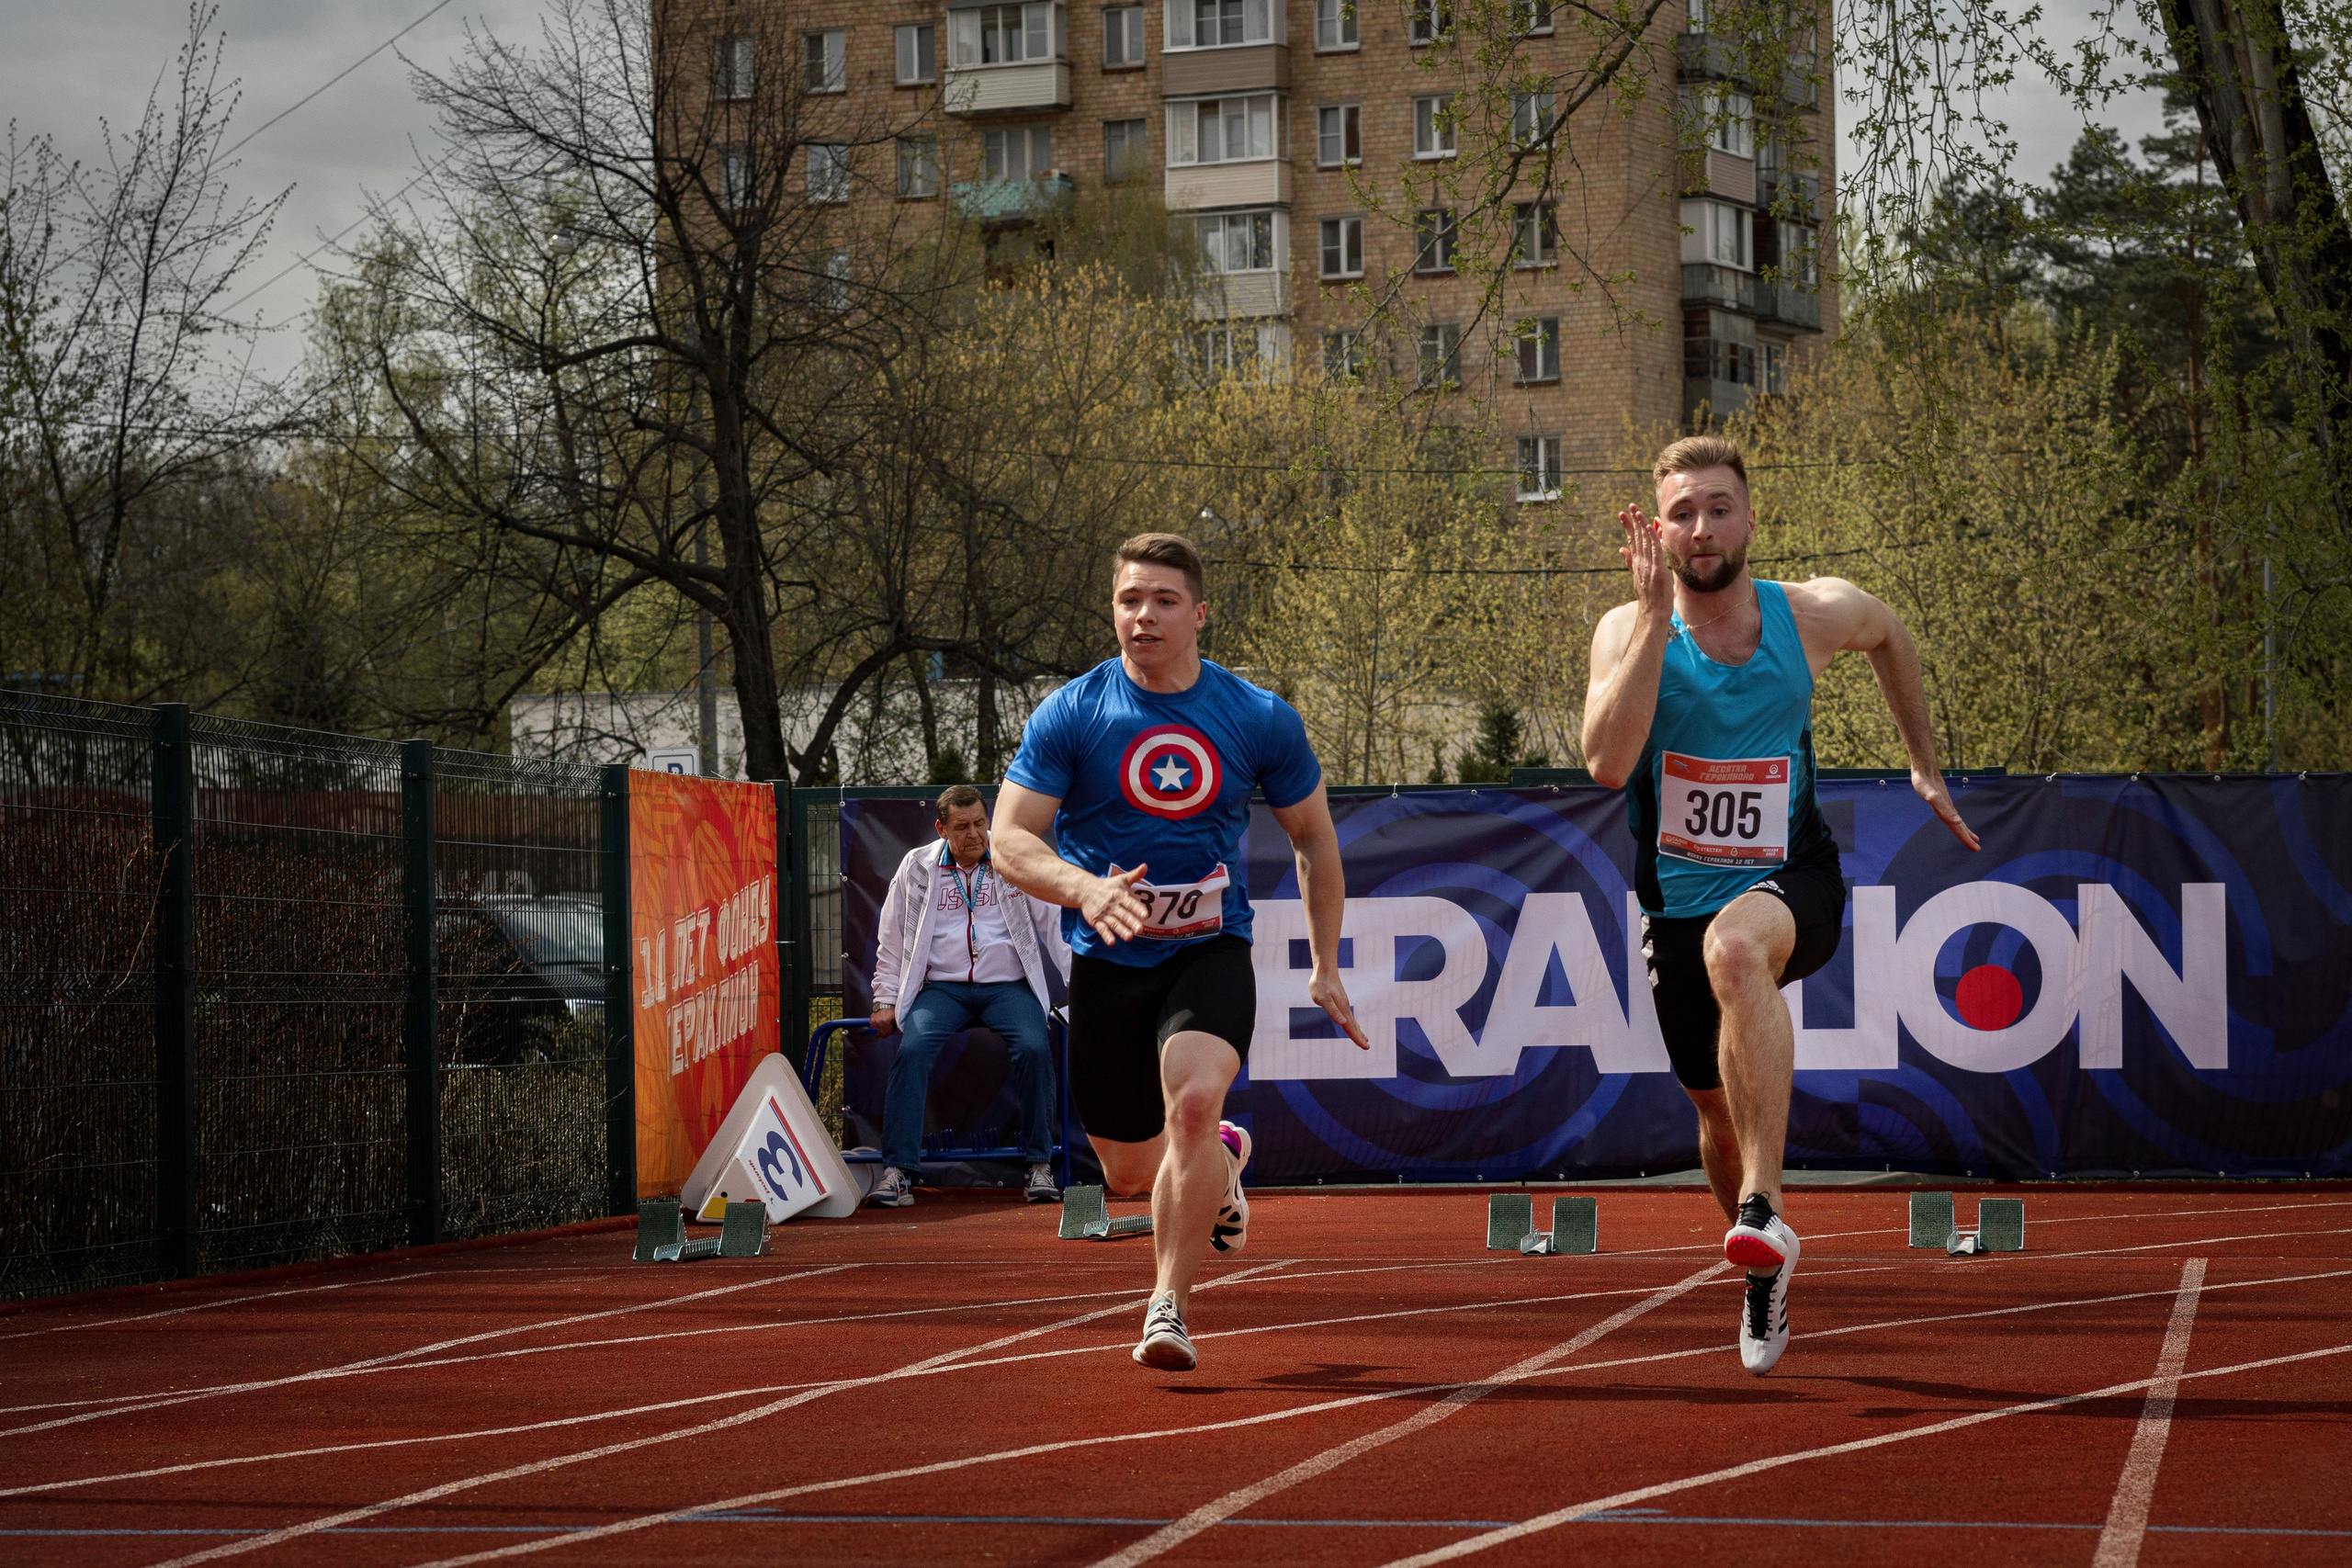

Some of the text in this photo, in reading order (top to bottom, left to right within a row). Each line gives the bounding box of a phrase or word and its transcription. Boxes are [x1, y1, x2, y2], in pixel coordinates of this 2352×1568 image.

[1685, 790, 1762, 840] 305
[640, 874, 770, 1010] 10 ЛЕТ ФОНДУ
[1134, 889, 1204, 925] 370
[666, 960, 759, 1082] ГЕРАКЛИОН
[757, 1130, 803, 1201] 3
